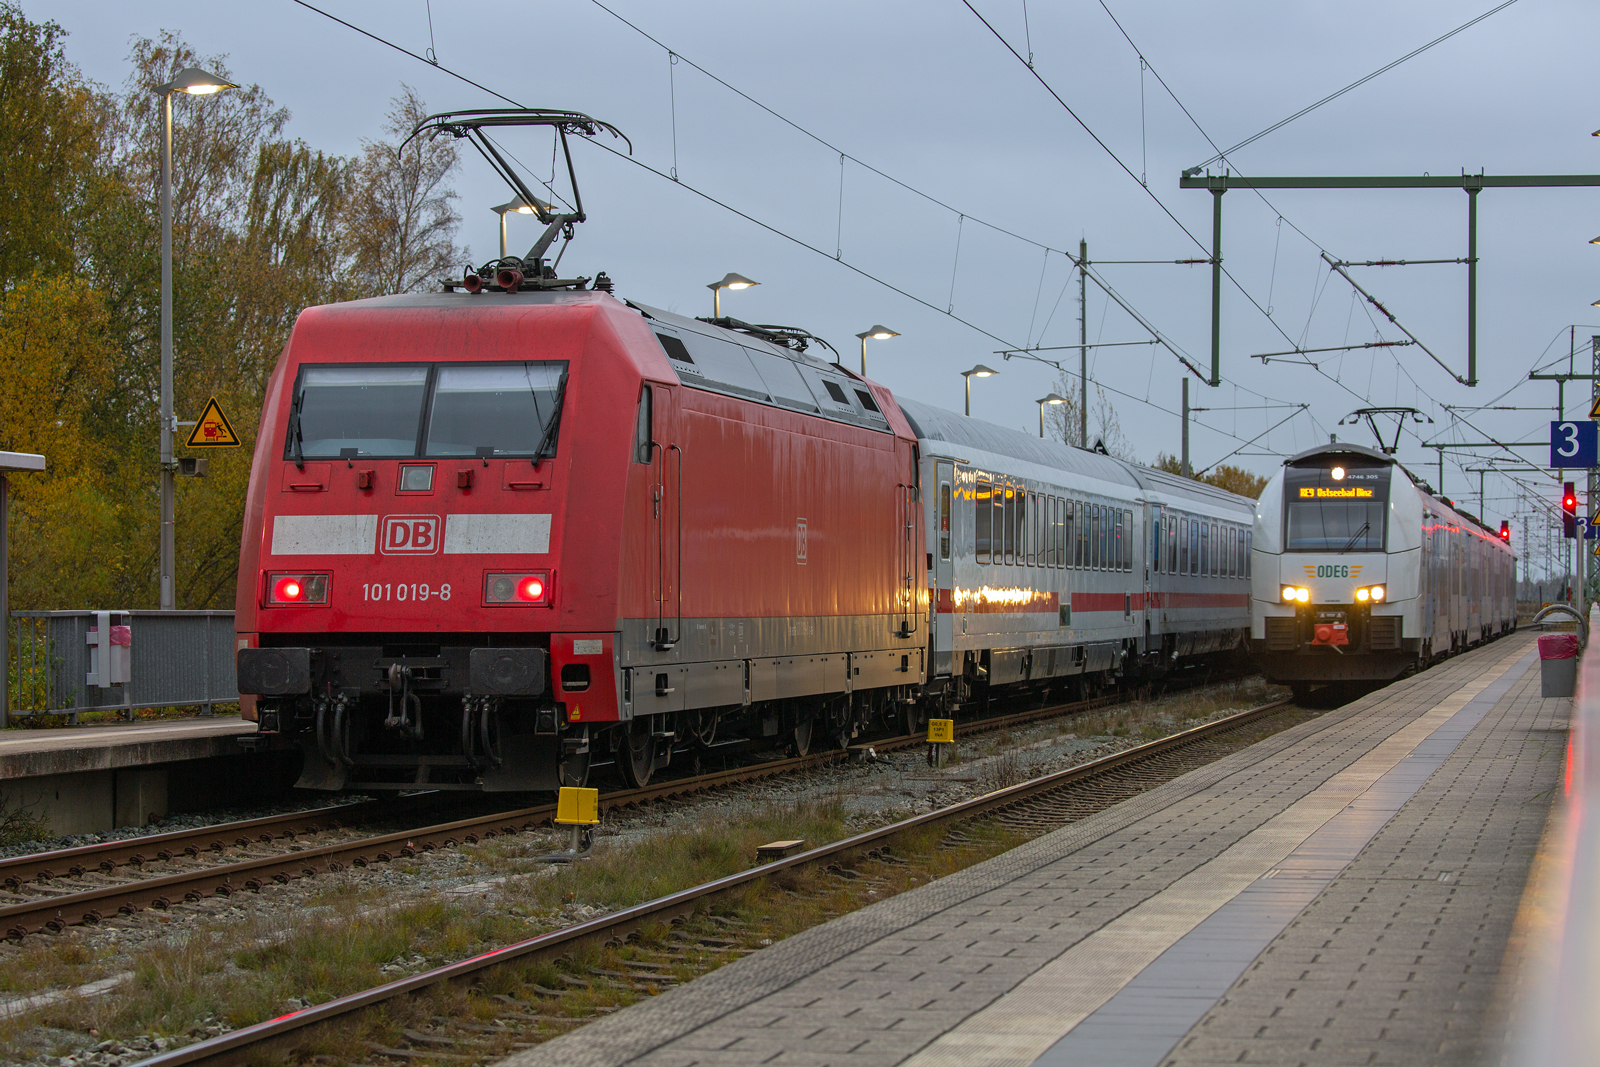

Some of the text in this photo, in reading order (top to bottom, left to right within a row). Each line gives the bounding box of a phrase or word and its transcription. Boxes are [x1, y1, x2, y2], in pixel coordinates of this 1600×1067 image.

[1557, 422, 1580, 457] 3
[1300, 487, 1373, 498] RE9 Ostseebad Binz
[388, 521, 432, 548] DB
[1317, 565, 1349, 578] ODEG
